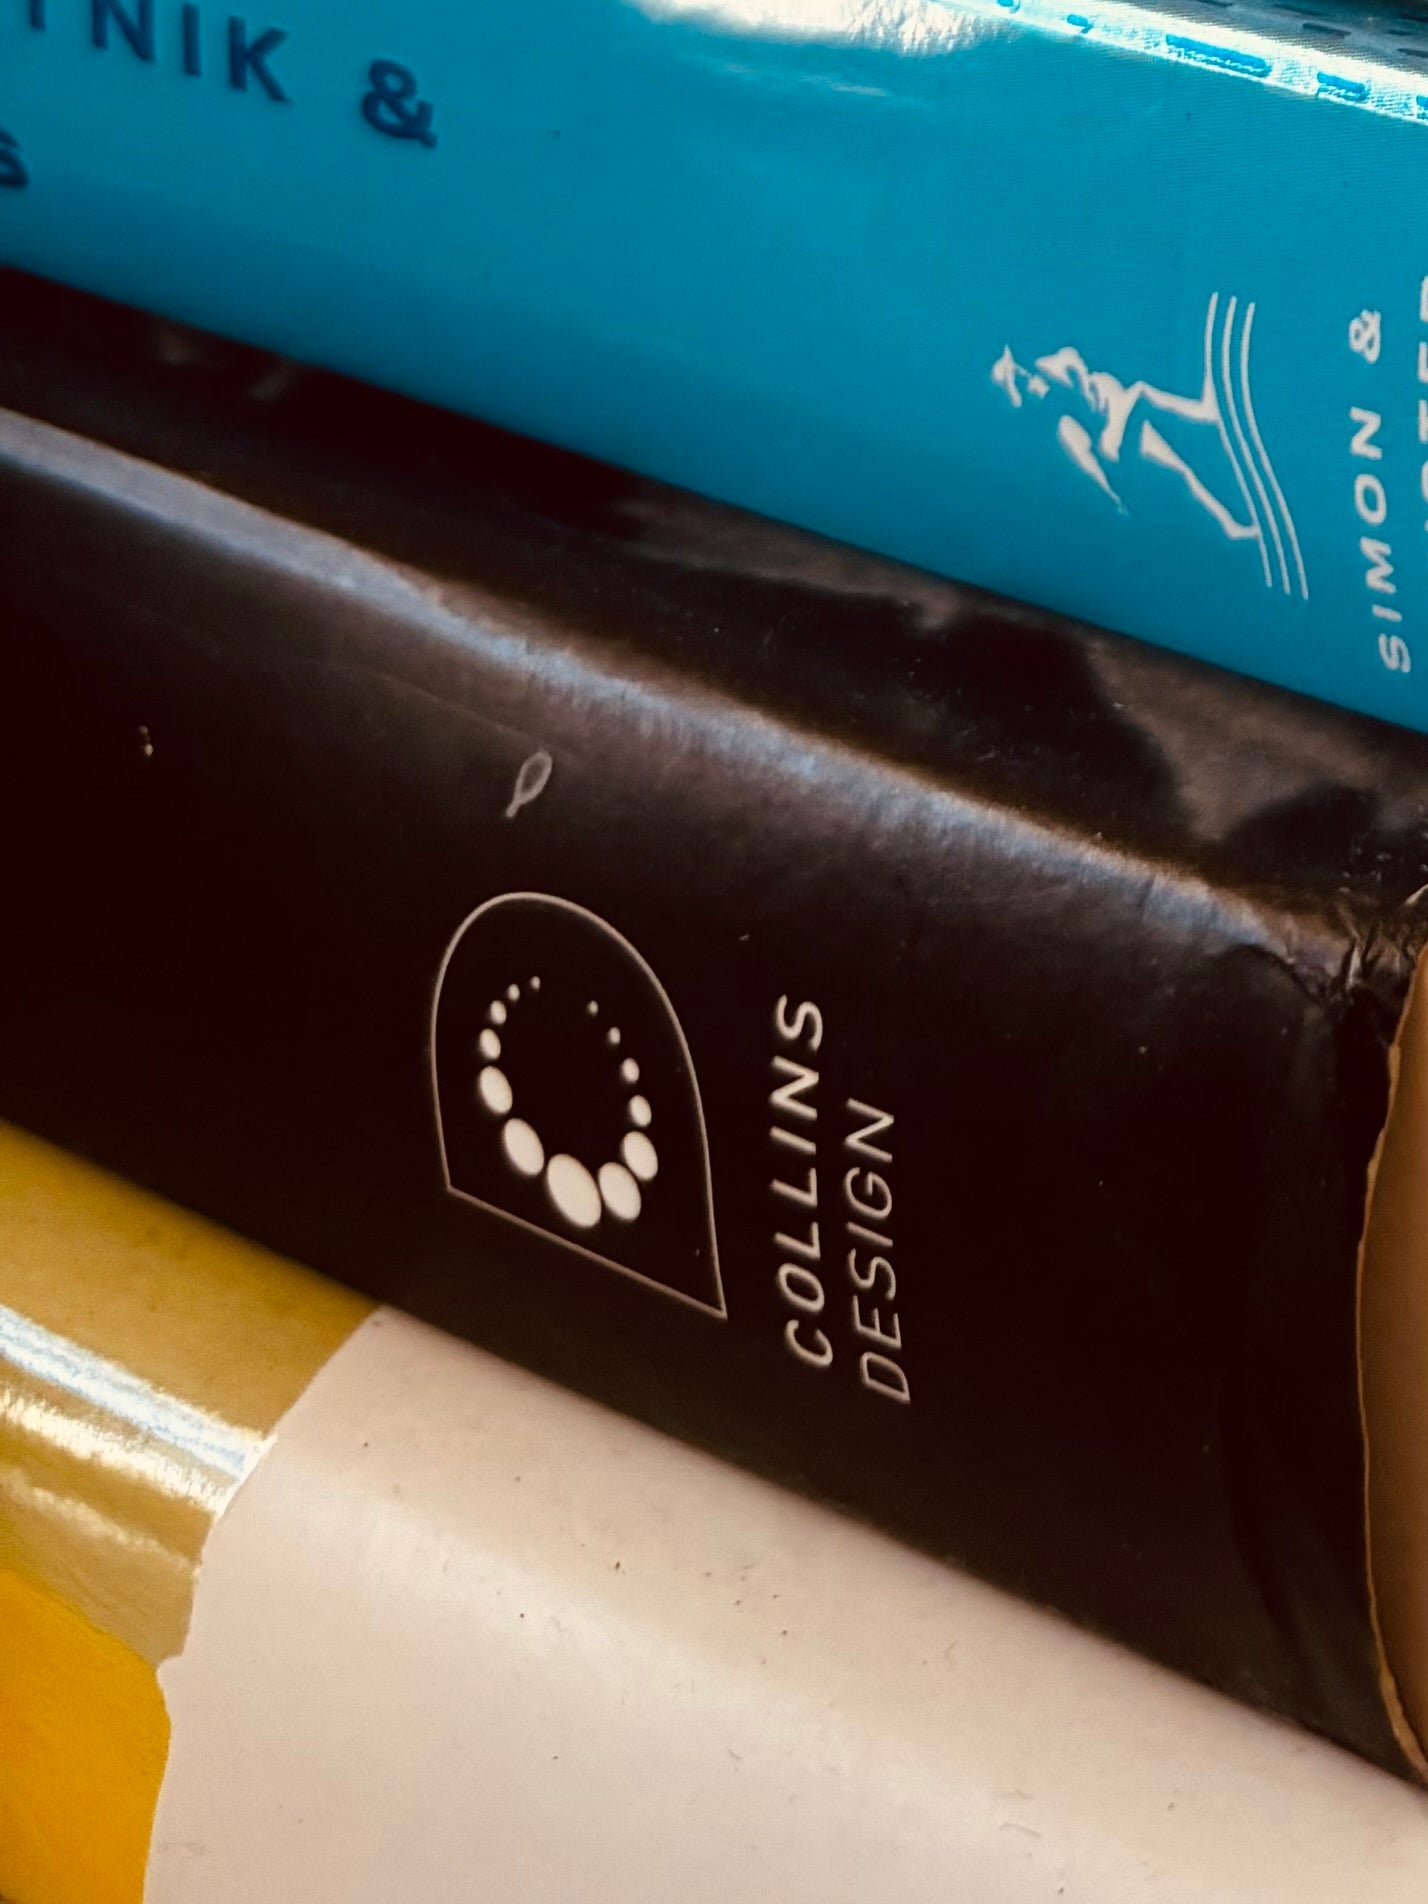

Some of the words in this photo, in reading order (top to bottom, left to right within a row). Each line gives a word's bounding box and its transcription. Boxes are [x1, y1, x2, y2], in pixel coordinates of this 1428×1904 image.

[361, 58, 438, 149] &
[1348, 309, 1383, 364] &
[1349, 406, 1412, 674] SIMON
[769, 994, 834, 1368] COLLINS
[844, 1097, 912, 1405] DESIGN
